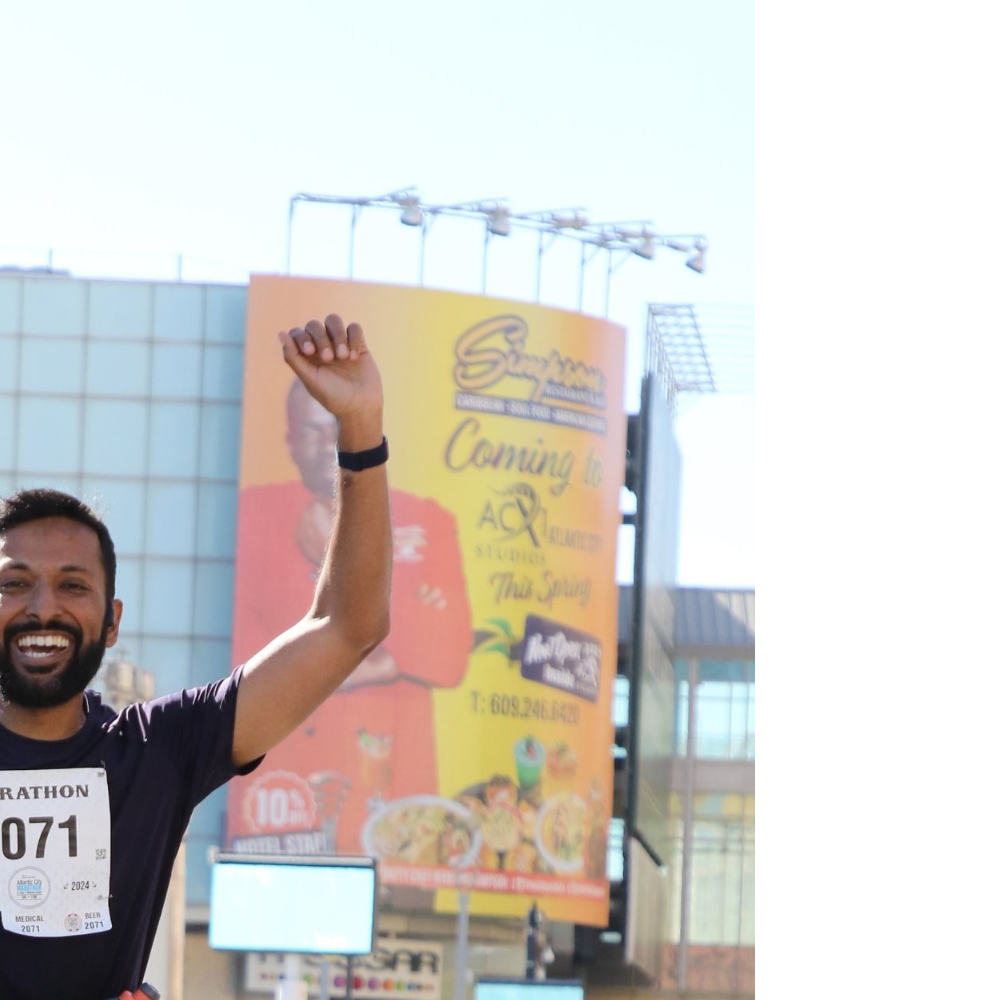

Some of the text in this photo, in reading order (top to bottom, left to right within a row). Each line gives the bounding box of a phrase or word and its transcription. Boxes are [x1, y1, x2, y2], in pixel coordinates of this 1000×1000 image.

[454, 314, 607, 406] Simpson
[445, 416, 604, 497] Coming to
[475, 543, 547, 566] STUDIOS
[489, 568, 592, 611] This Spring
[71, 881, 90, 891] 2024
[84, 921, 104, 929] 2071
